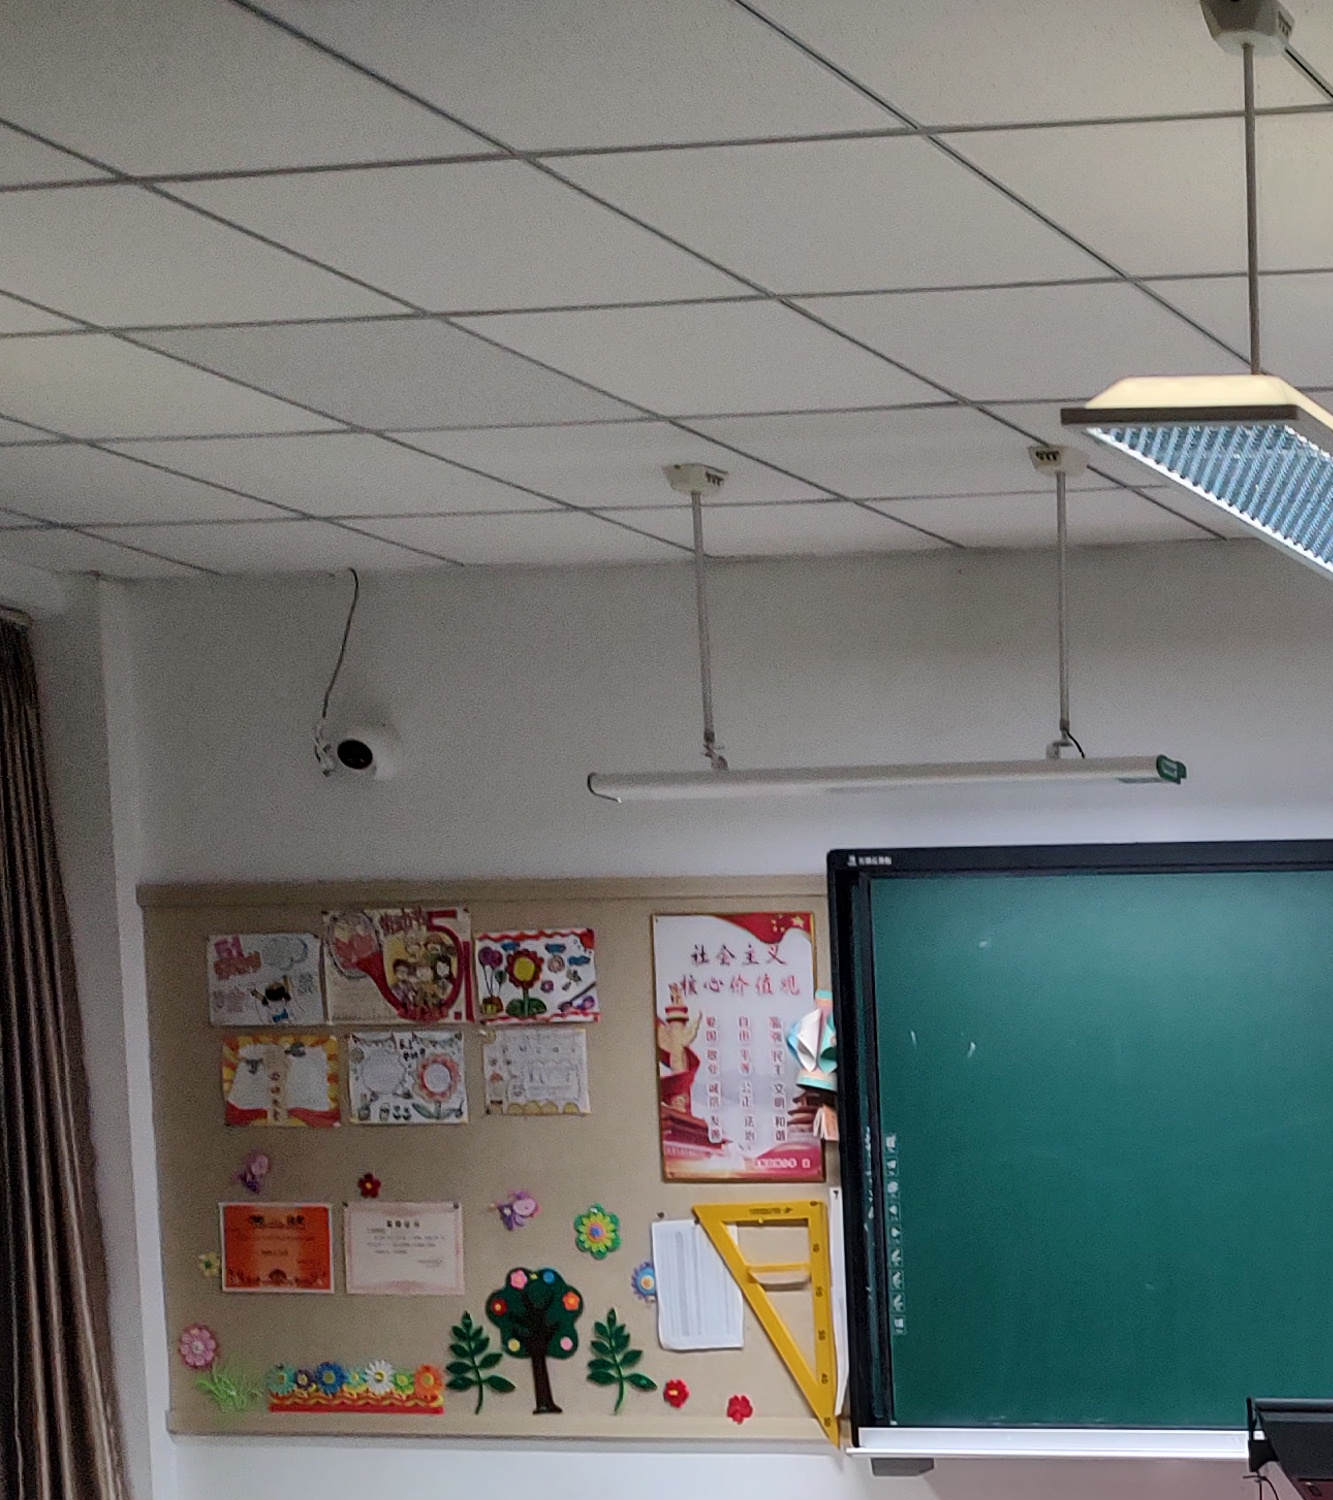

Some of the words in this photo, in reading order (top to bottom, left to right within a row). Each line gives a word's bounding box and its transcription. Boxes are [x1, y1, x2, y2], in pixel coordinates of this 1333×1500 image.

[691, 944, 787, 966] 社会主义
[682, 974, 800, 996] 核心价值观
